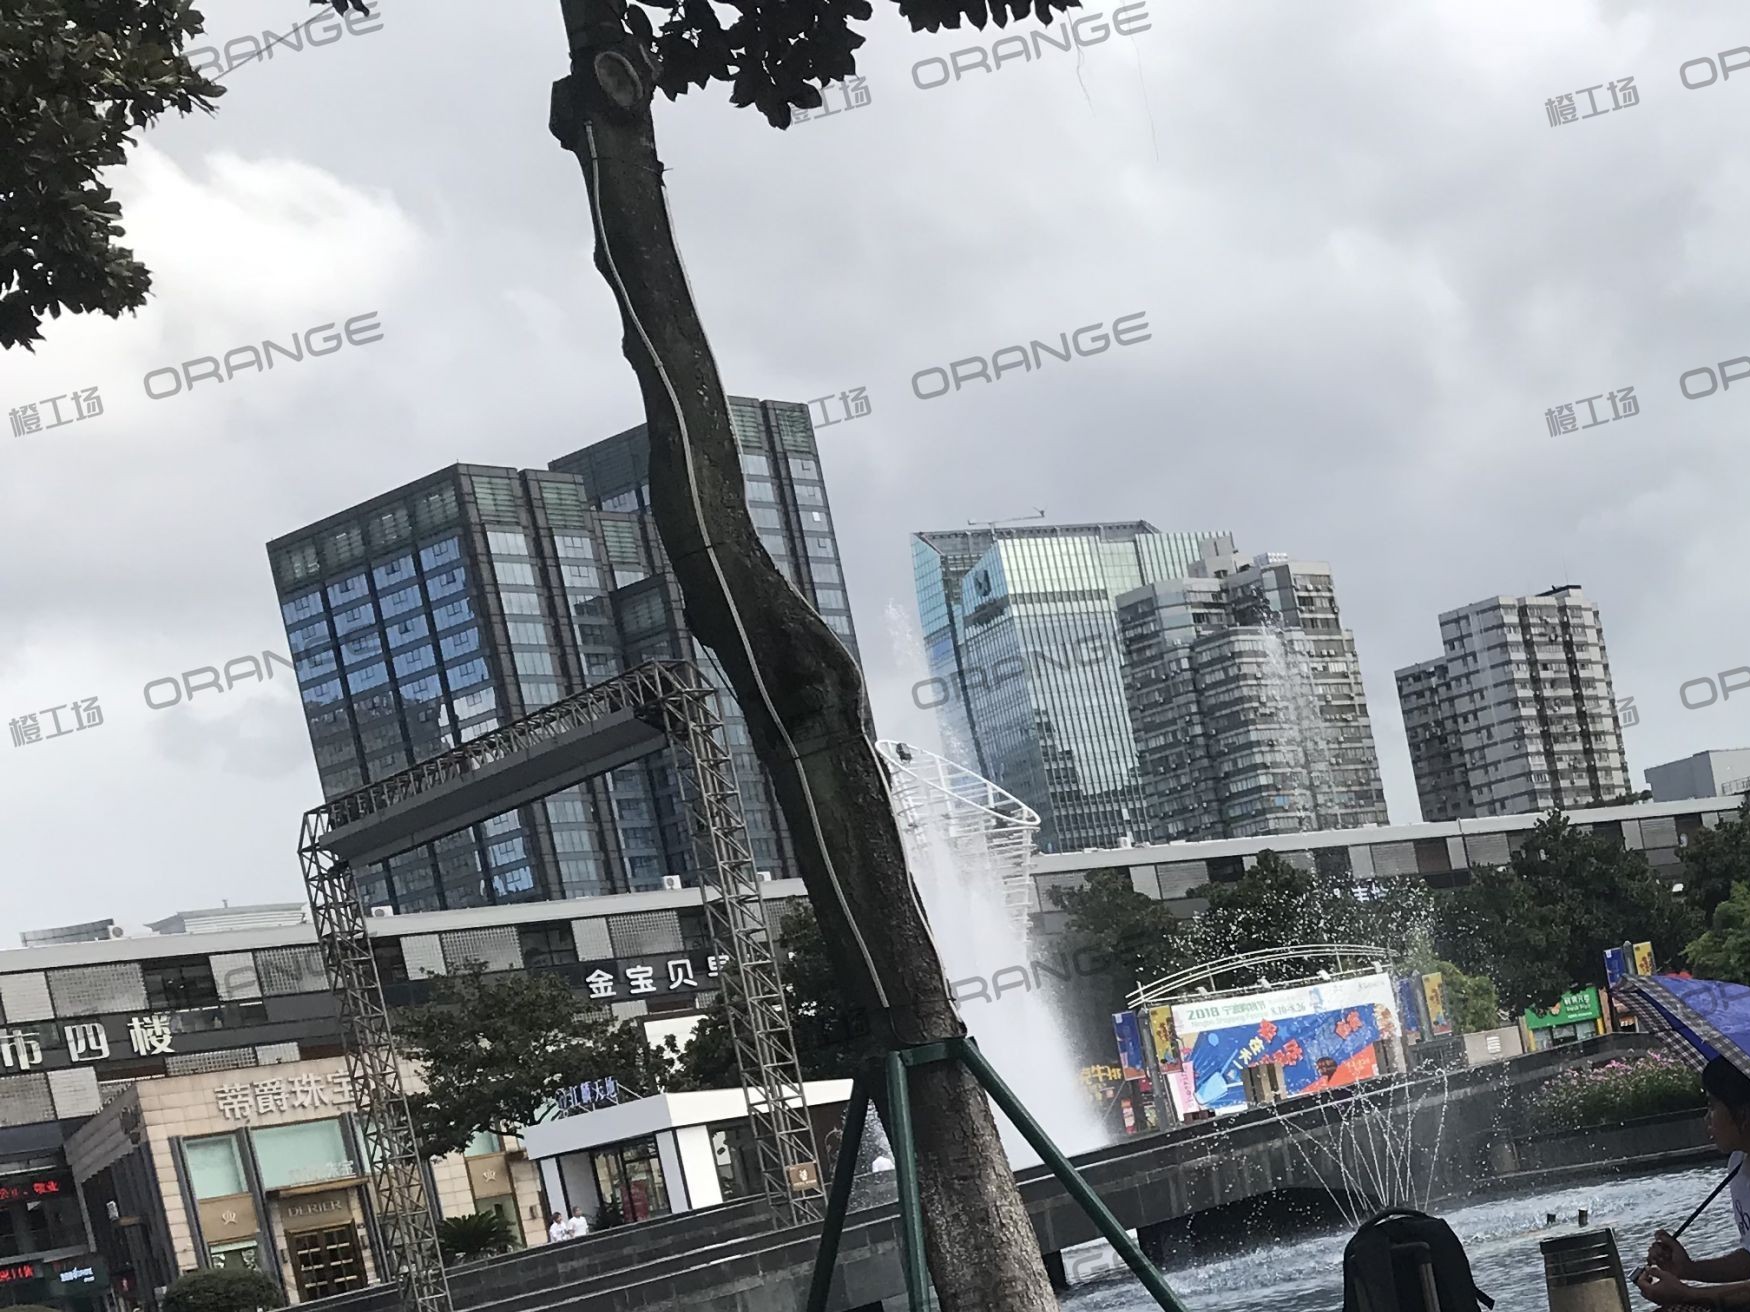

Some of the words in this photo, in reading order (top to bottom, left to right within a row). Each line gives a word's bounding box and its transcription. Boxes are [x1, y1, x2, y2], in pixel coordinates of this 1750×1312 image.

[1186, 1006, 1221, 1021] 2018
[0, 1014, 176, 1070] 市四楼
[288, 1200, 343, 1217] DERIER
